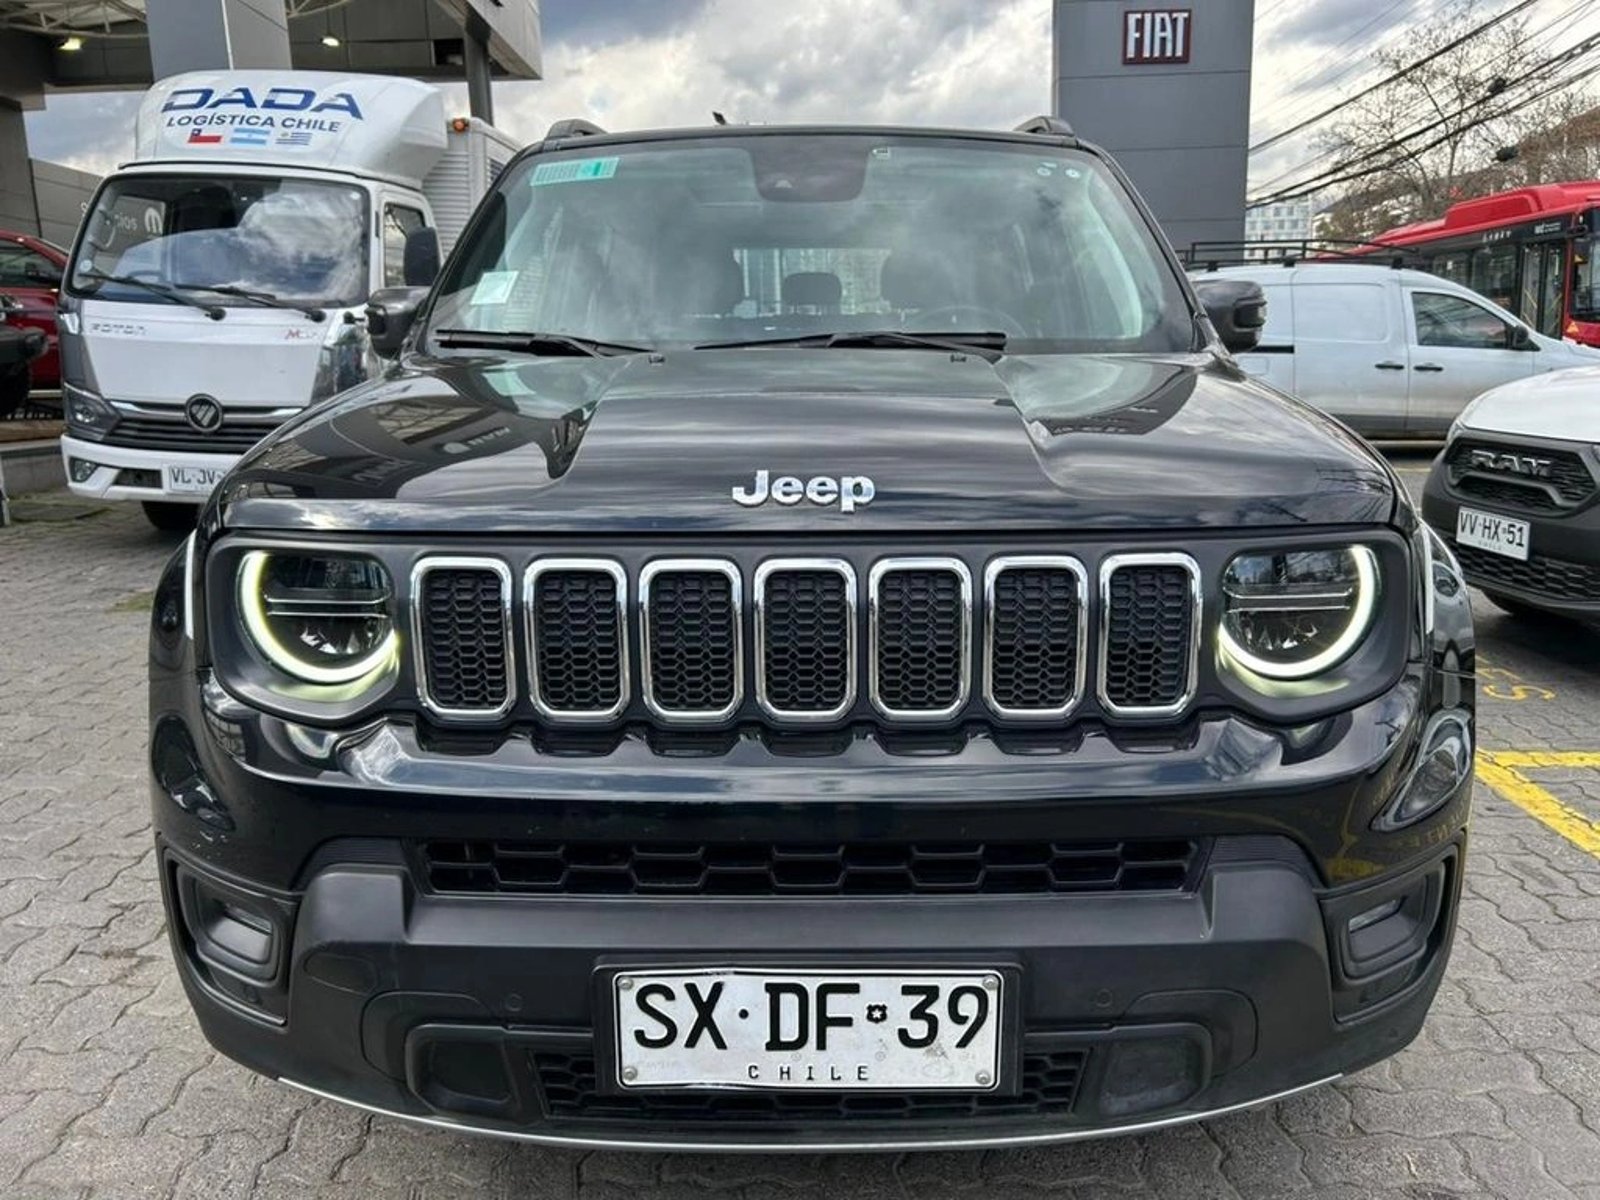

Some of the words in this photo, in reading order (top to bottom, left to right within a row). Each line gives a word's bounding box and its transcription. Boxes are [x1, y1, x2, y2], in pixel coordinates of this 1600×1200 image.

[1126, 12, 1189, 58] FIAT
[161, 87, 364, 121] DADA
[167, 112, 275, 128] LOGÍSTICA
[281, 117, 342, 133] CHILE
[732, 469, 875, 513] Jeep
[748, 1064, 869, 1081] CHILE
